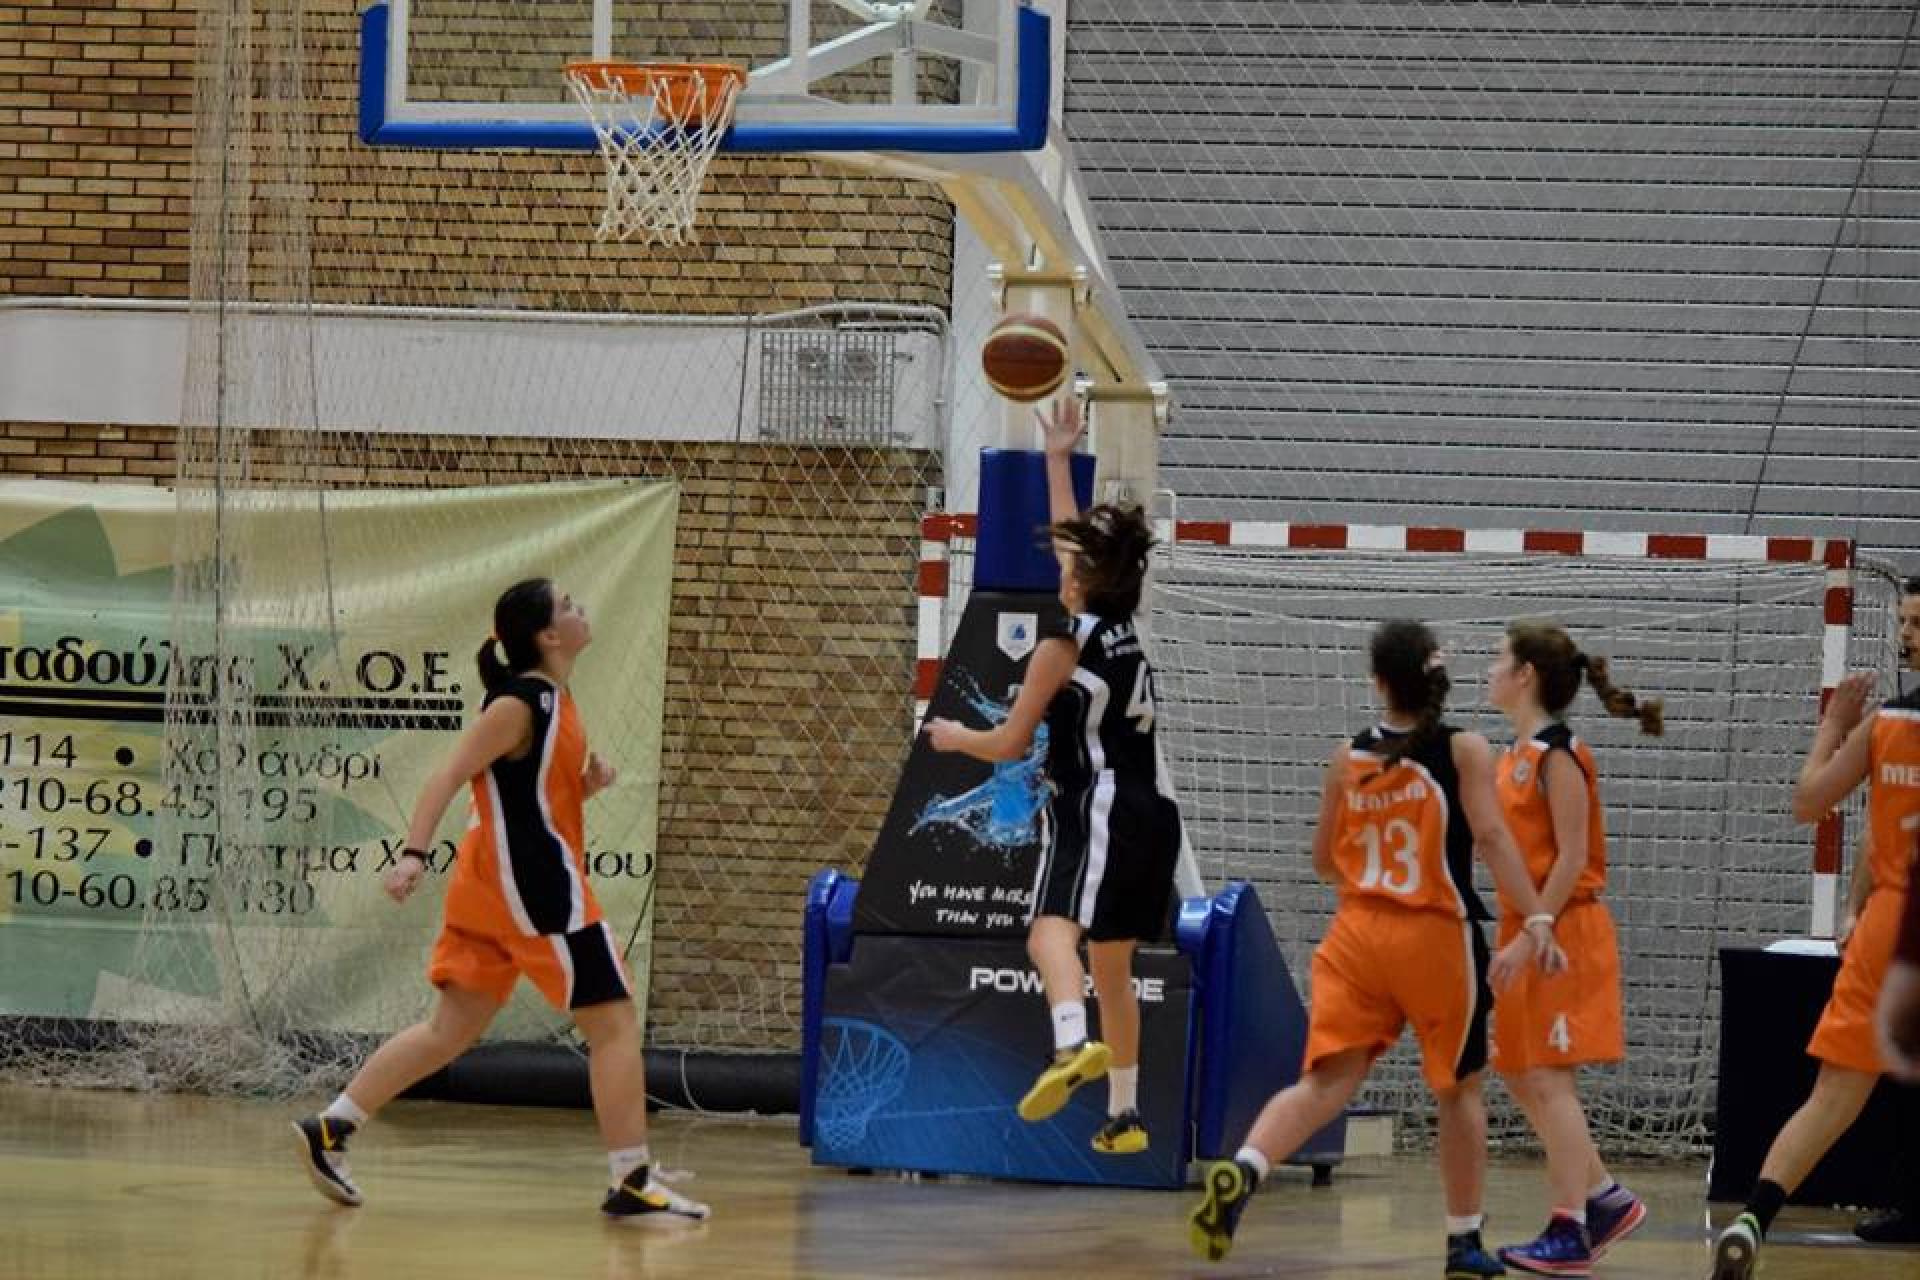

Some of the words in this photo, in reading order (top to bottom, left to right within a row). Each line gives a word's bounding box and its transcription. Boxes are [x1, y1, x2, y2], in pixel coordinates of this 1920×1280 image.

[1125, 660, 1154, 735] 4
[0, 731, 78, 768] 114
[0, 777, 215, 819] 10-68.45
[1355, 818, 1421, 893] 13
[969, 966, 1165, 1002] POWRE
[1548, 1013, 1571, 1053] 4
